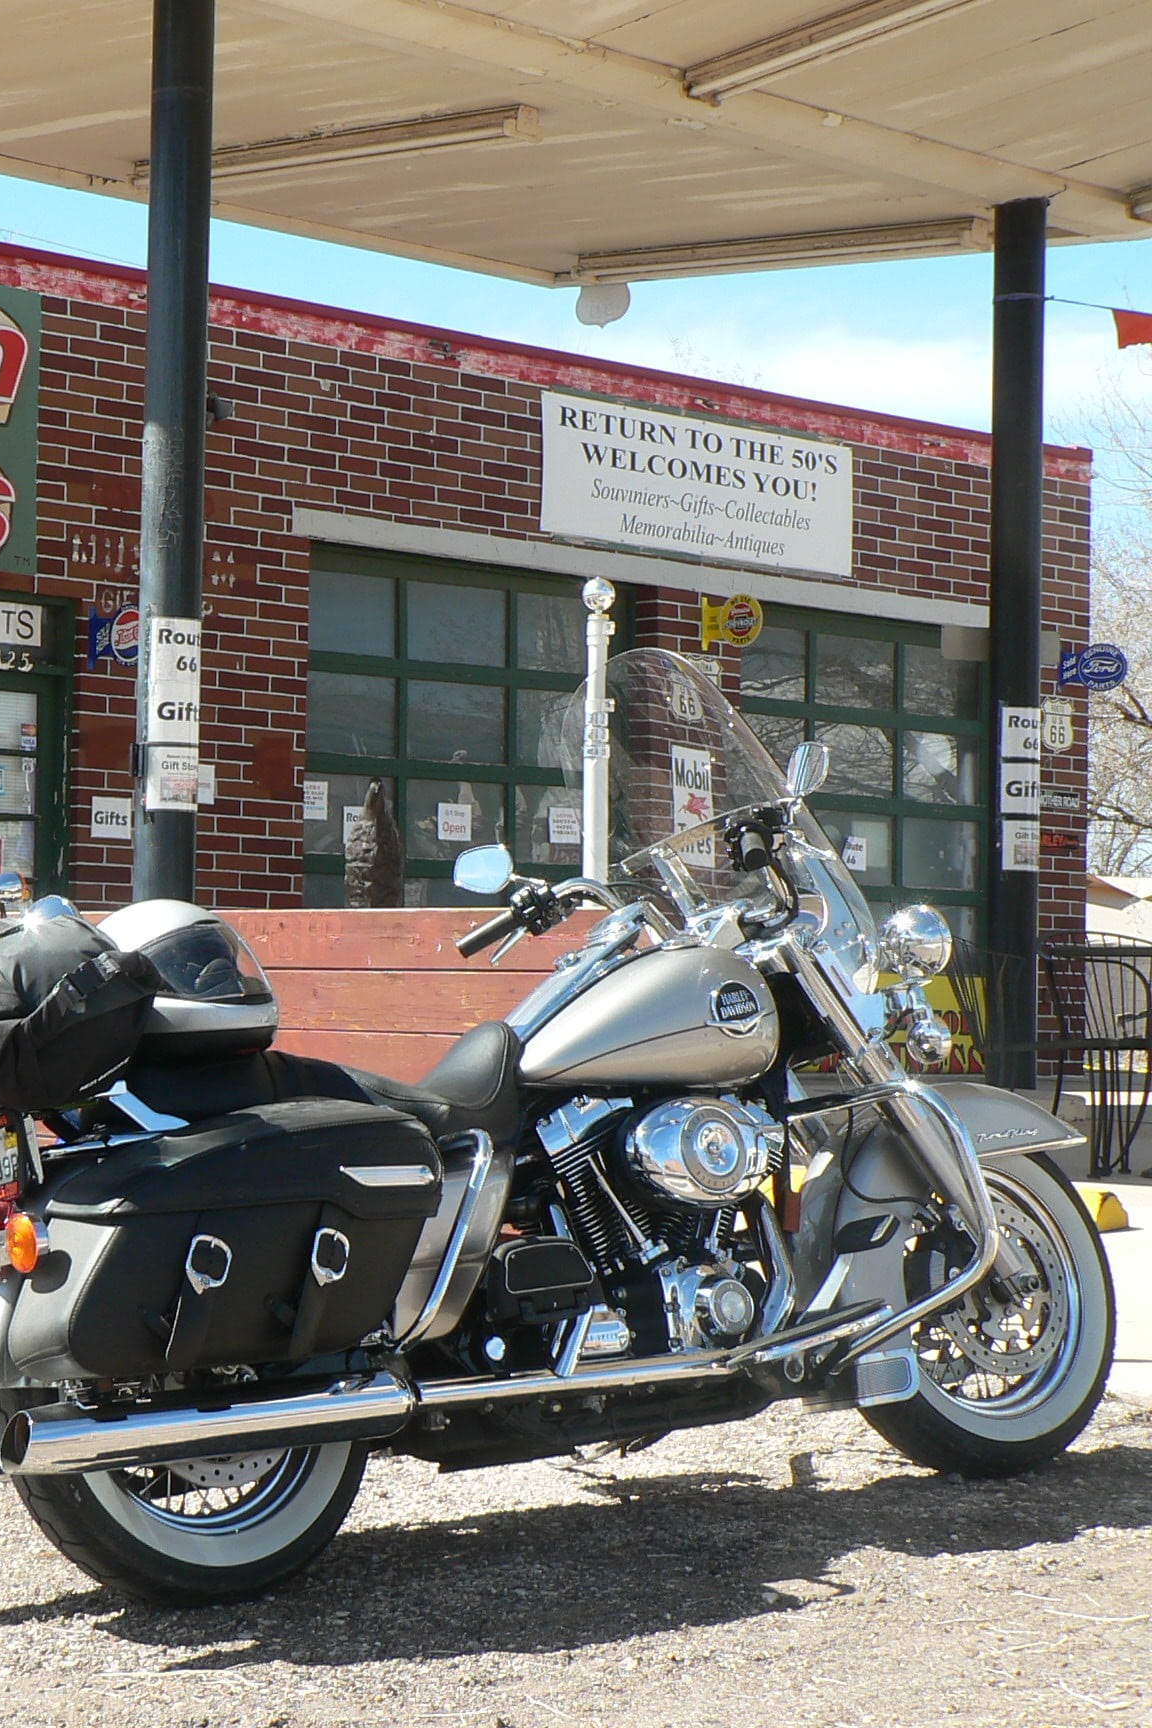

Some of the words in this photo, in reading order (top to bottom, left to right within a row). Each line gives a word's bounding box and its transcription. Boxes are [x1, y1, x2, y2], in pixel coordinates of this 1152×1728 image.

[559, 405, 677, 447] RETURN
[685, 428, 723, 454] TO
[729, 437, 784, 466] THE
[791, 449, 838, 476] 50'S
[581, 441, 746, 490] WELCOMES
[753, 471, 818, 502] YOU!
[14, 555, 32, 567] TM
[158, 628, 201, 646] Rout
[176, 655, 198, 673] 66
[1082, 659, 1119, 673] Ford
[156, 700, 200, 722] Gift
[679, 694, 696, 715] 66
[1049, 726, 1066, 745] 66
[161, 760, 180, 771] Gift
[674, 757, 710, 792] Mobil
[93, 810, 129, 826] Gifts
[442, 820, 467, 834] Open
